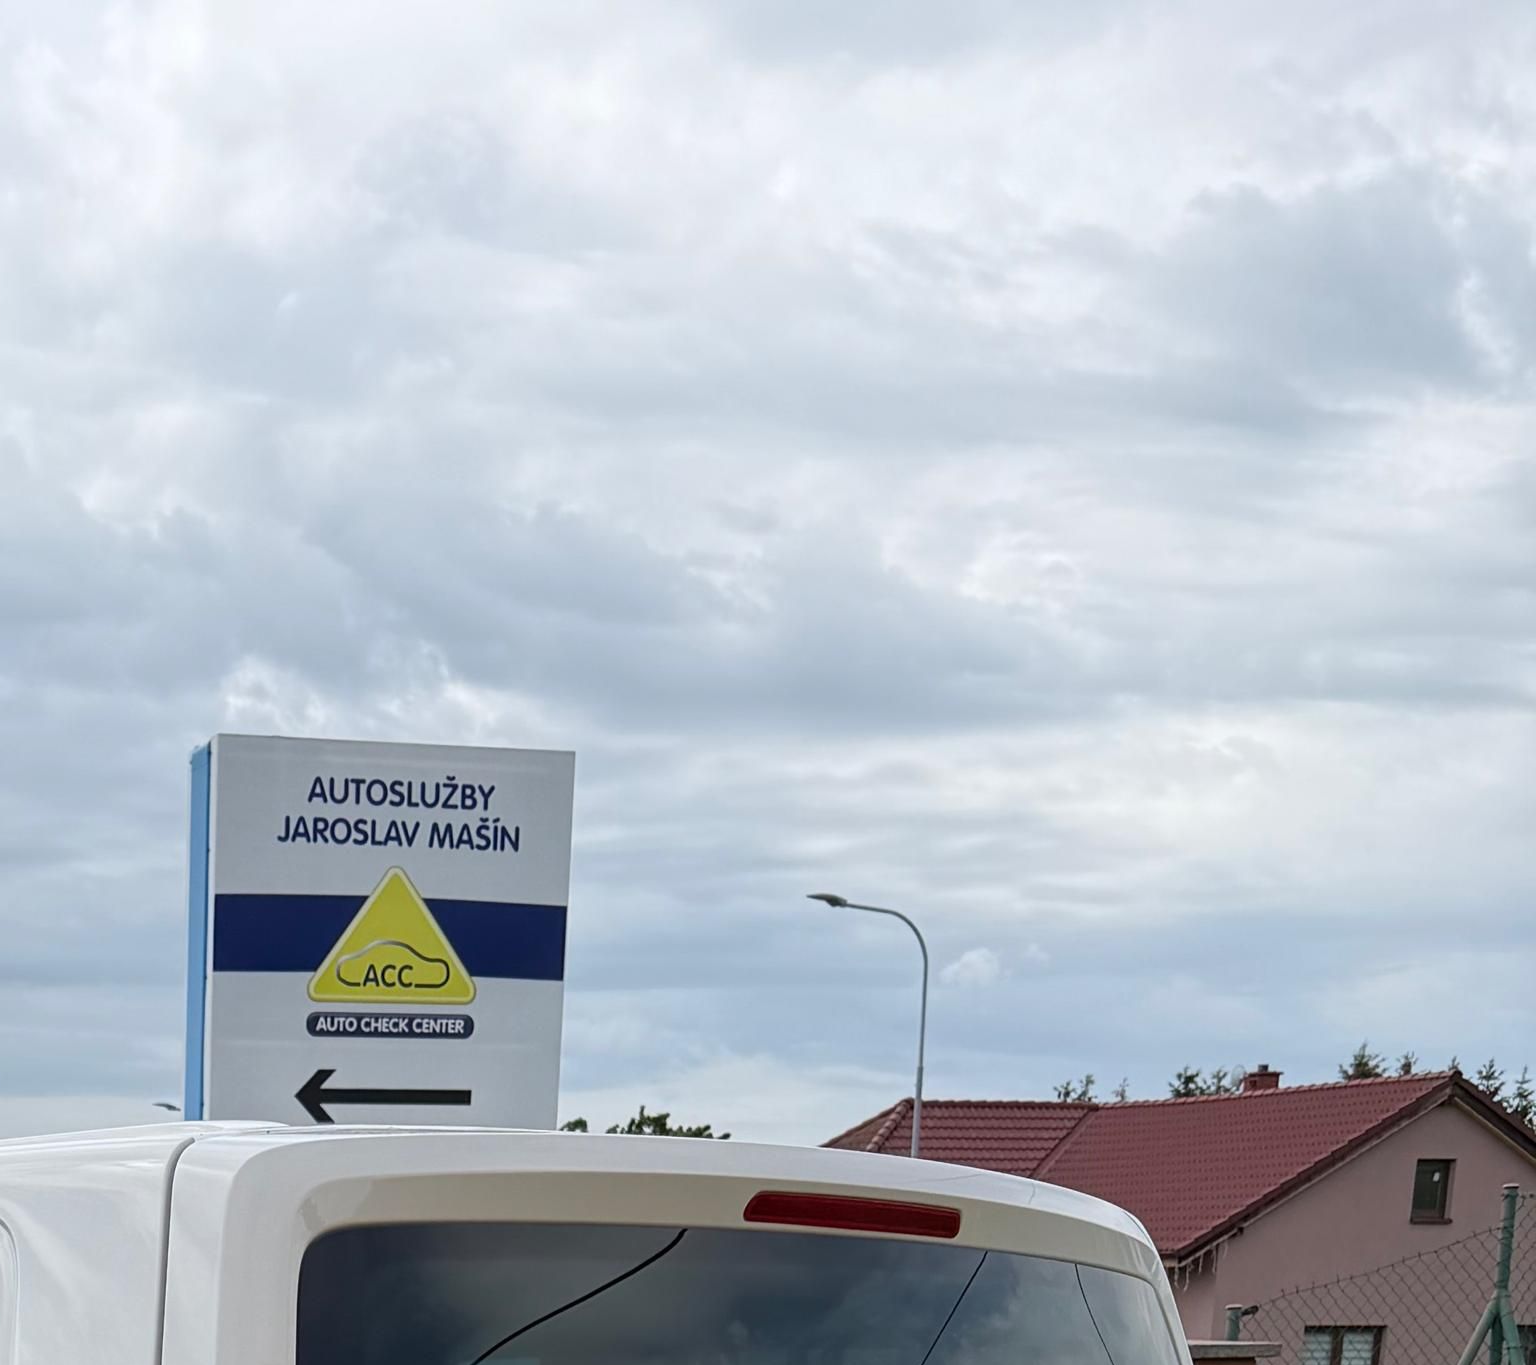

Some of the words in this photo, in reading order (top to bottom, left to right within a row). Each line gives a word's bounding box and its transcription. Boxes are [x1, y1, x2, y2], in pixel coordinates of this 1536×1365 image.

[307, 775, 496, 812] AUTOSLUŽBY
[277, 815, 421, 848] JAROSLAV
[428, 817, 521, 853] MAŠÍN
[362, 963, 415, 989] ACC
[315, 1016, 358, 1033] AUTO
[360, 1017, 409, 1033] CHECK
[412, 1018, 465, 1034] CENTER
